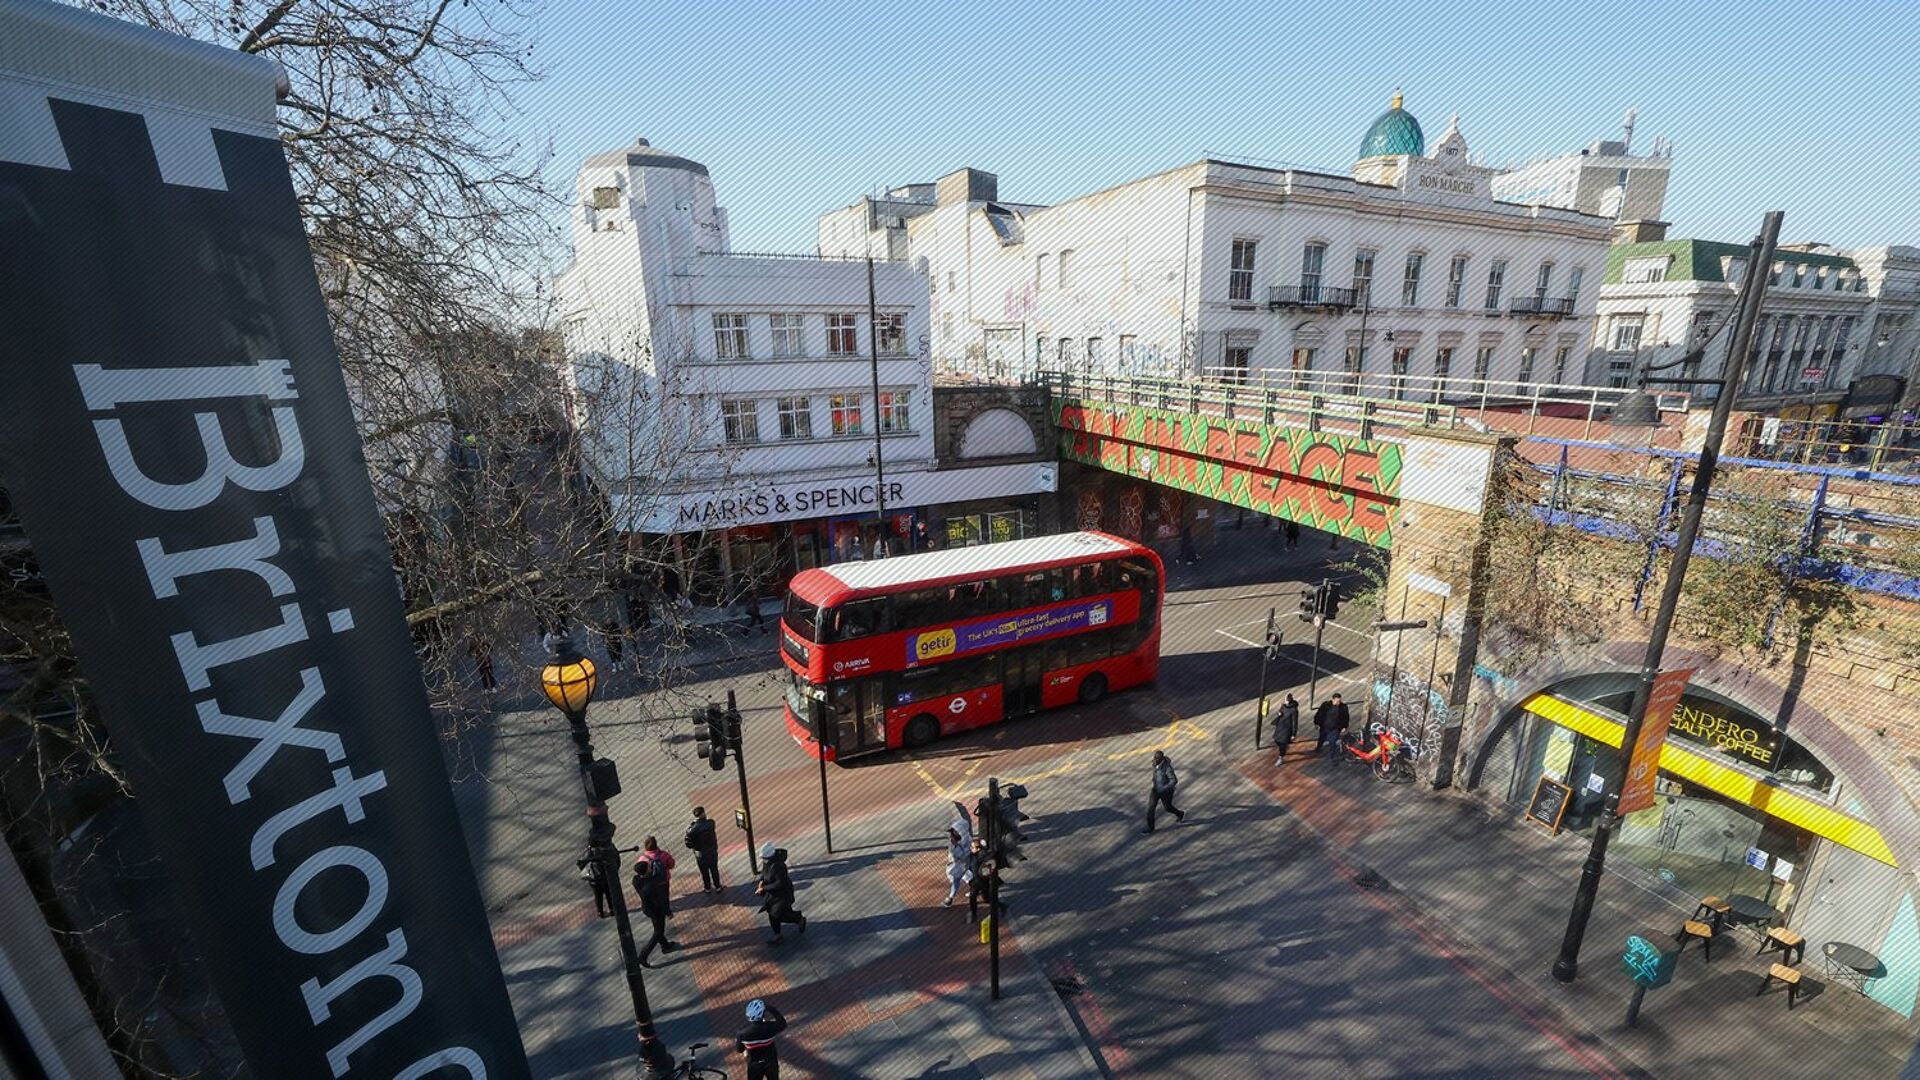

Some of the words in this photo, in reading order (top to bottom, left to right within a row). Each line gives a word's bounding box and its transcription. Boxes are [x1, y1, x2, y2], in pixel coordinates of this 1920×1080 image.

[1419, 175, 1438, 188] BON
[1206, 425, 1388, 534] PEACE
[680, 494, 770, 524] MARKS
[775, 493, 790, 513] &
[795, 483, 904, 511] SPENCER
[968, 632, 982, 642] The
[1018, 621, 1044, 636] grocery
[1045, 613, 1072, 628] delivery
[1072, 610, 1085, 621] app
[920, 634, 952, 655] getir
[844, 657, 870, 669] ARRIVA
[73, 358, 424, 1079] Brixton
[1673, 703, 1759, 745] ENDERO
[1717, 734, 1773, 764] COFFEE
